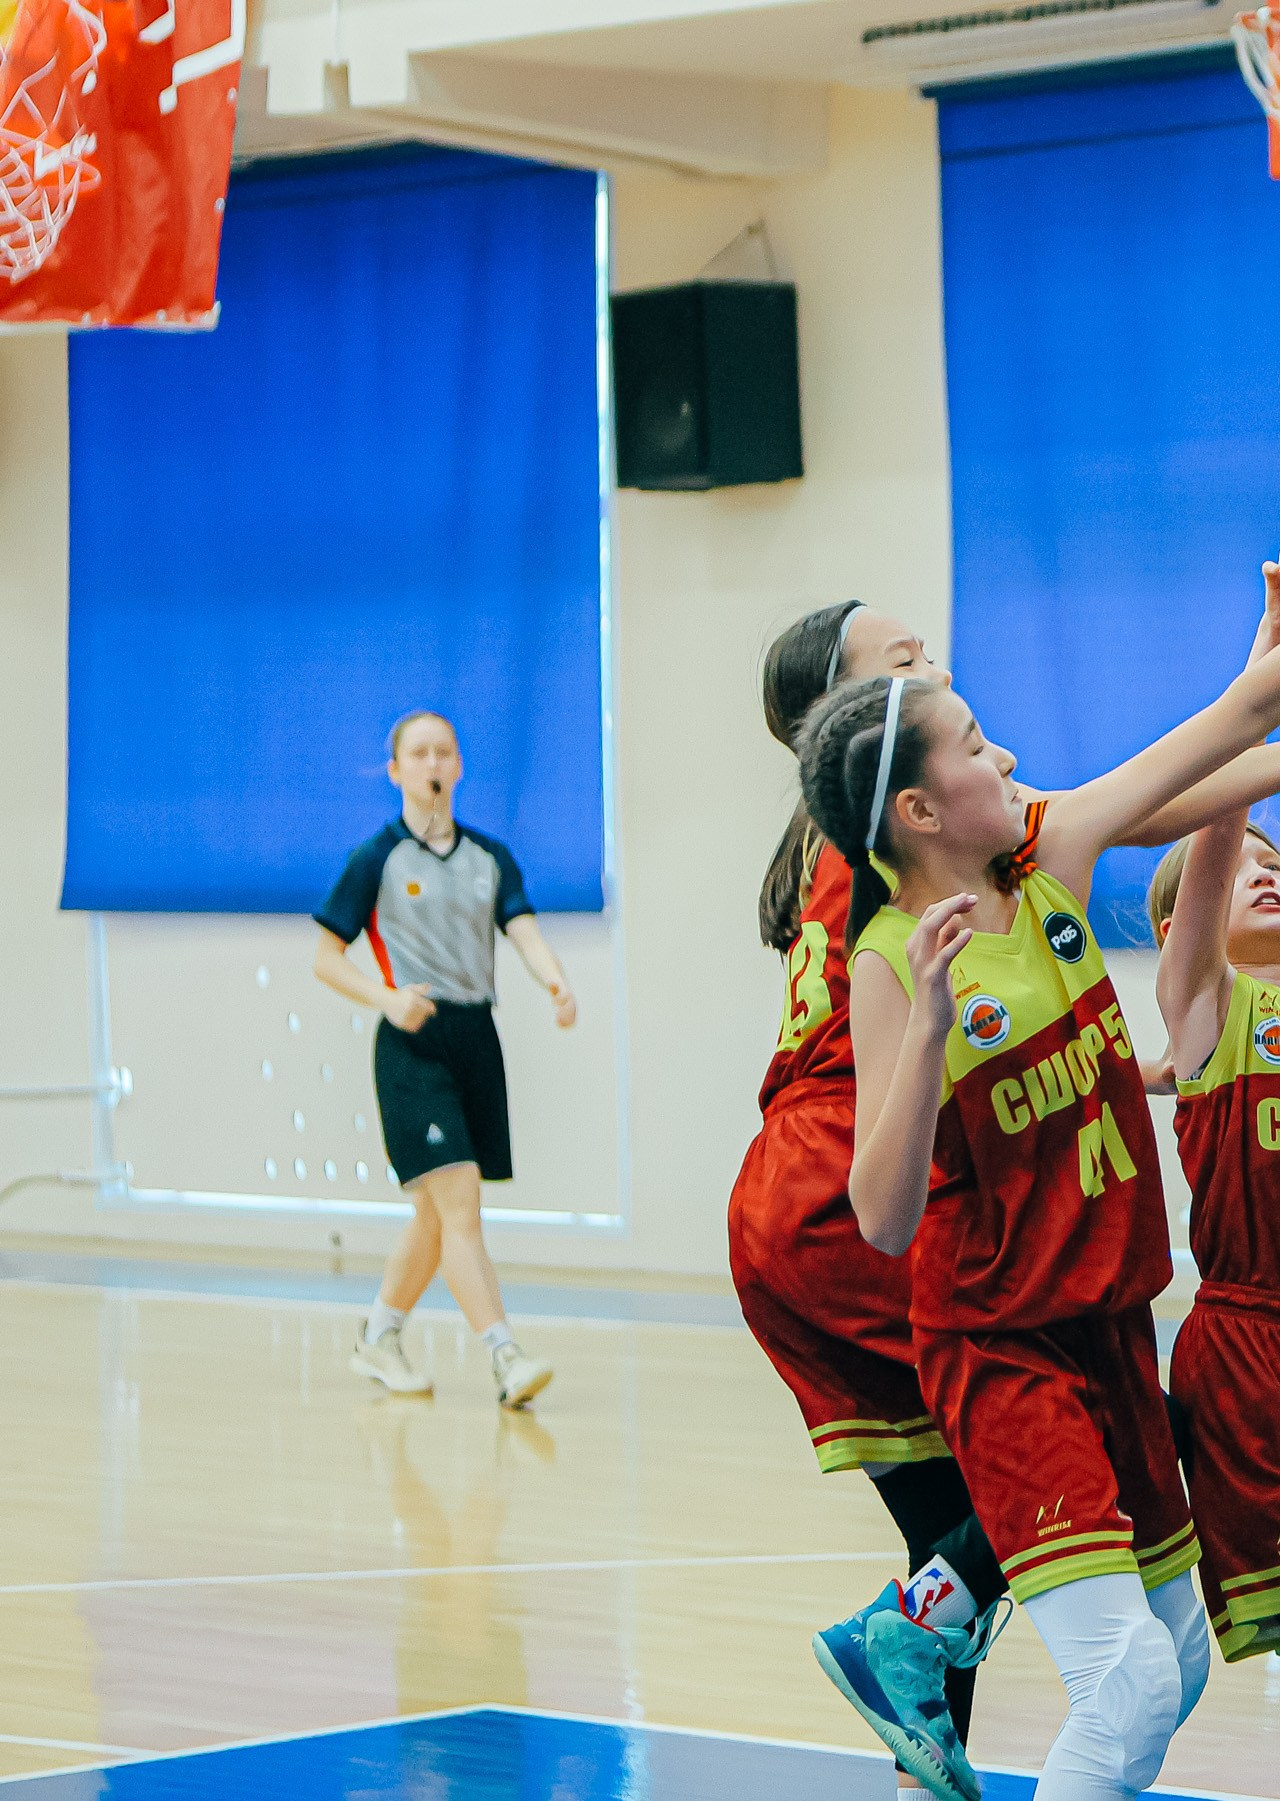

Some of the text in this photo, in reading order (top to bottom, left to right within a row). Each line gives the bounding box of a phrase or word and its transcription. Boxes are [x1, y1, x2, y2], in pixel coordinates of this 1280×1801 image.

[991, 1002, 1133, 1135] СШОР 5
[1077, 1101, 1138, 1199] 41
